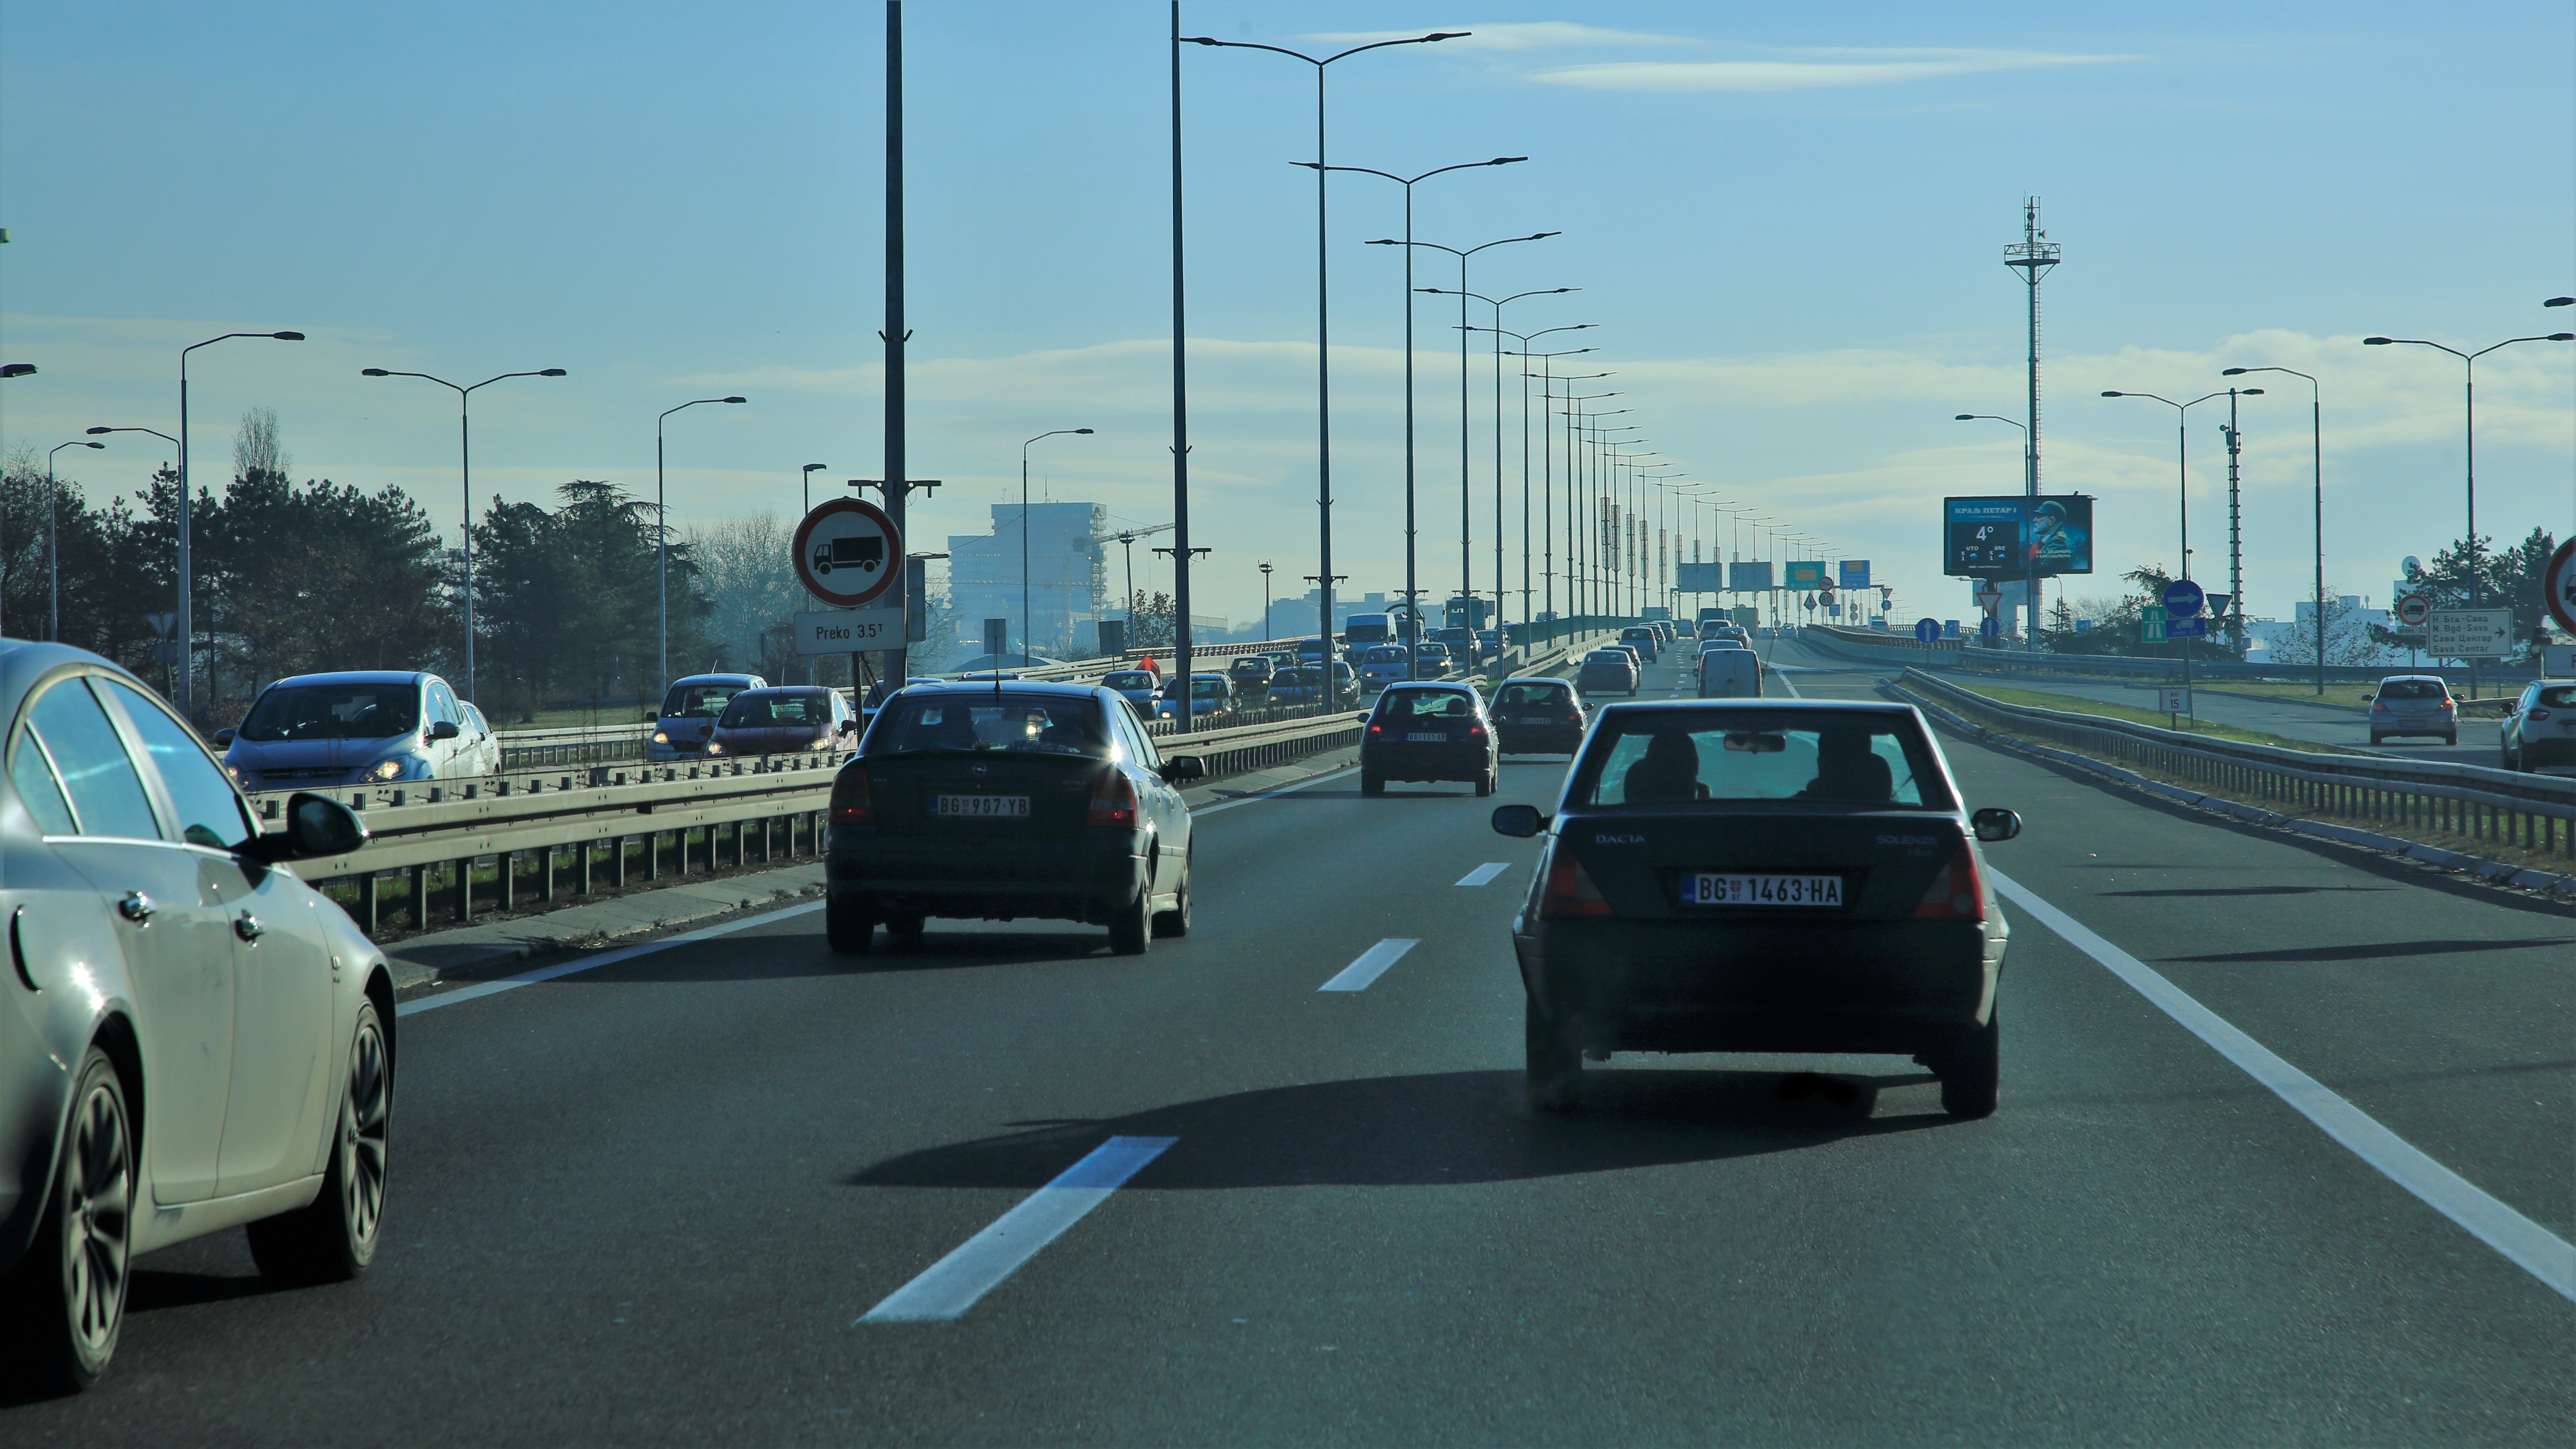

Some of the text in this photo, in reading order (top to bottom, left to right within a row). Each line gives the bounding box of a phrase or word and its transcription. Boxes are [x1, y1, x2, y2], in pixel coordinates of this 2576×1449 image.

[1821, 595, 1831, 604] 80
[816, 626, 850, 640] Preko
[2444, 624, 2489, 634] Bgd-Sava
[2459, 635, 2492, 643] Центар
[2170, 699, 2179, 709] 15
[940, 797, 959, 813] BG
[1596, 835, 1646, 843] DACIA
[1699, 877, 1727, 901] BG
